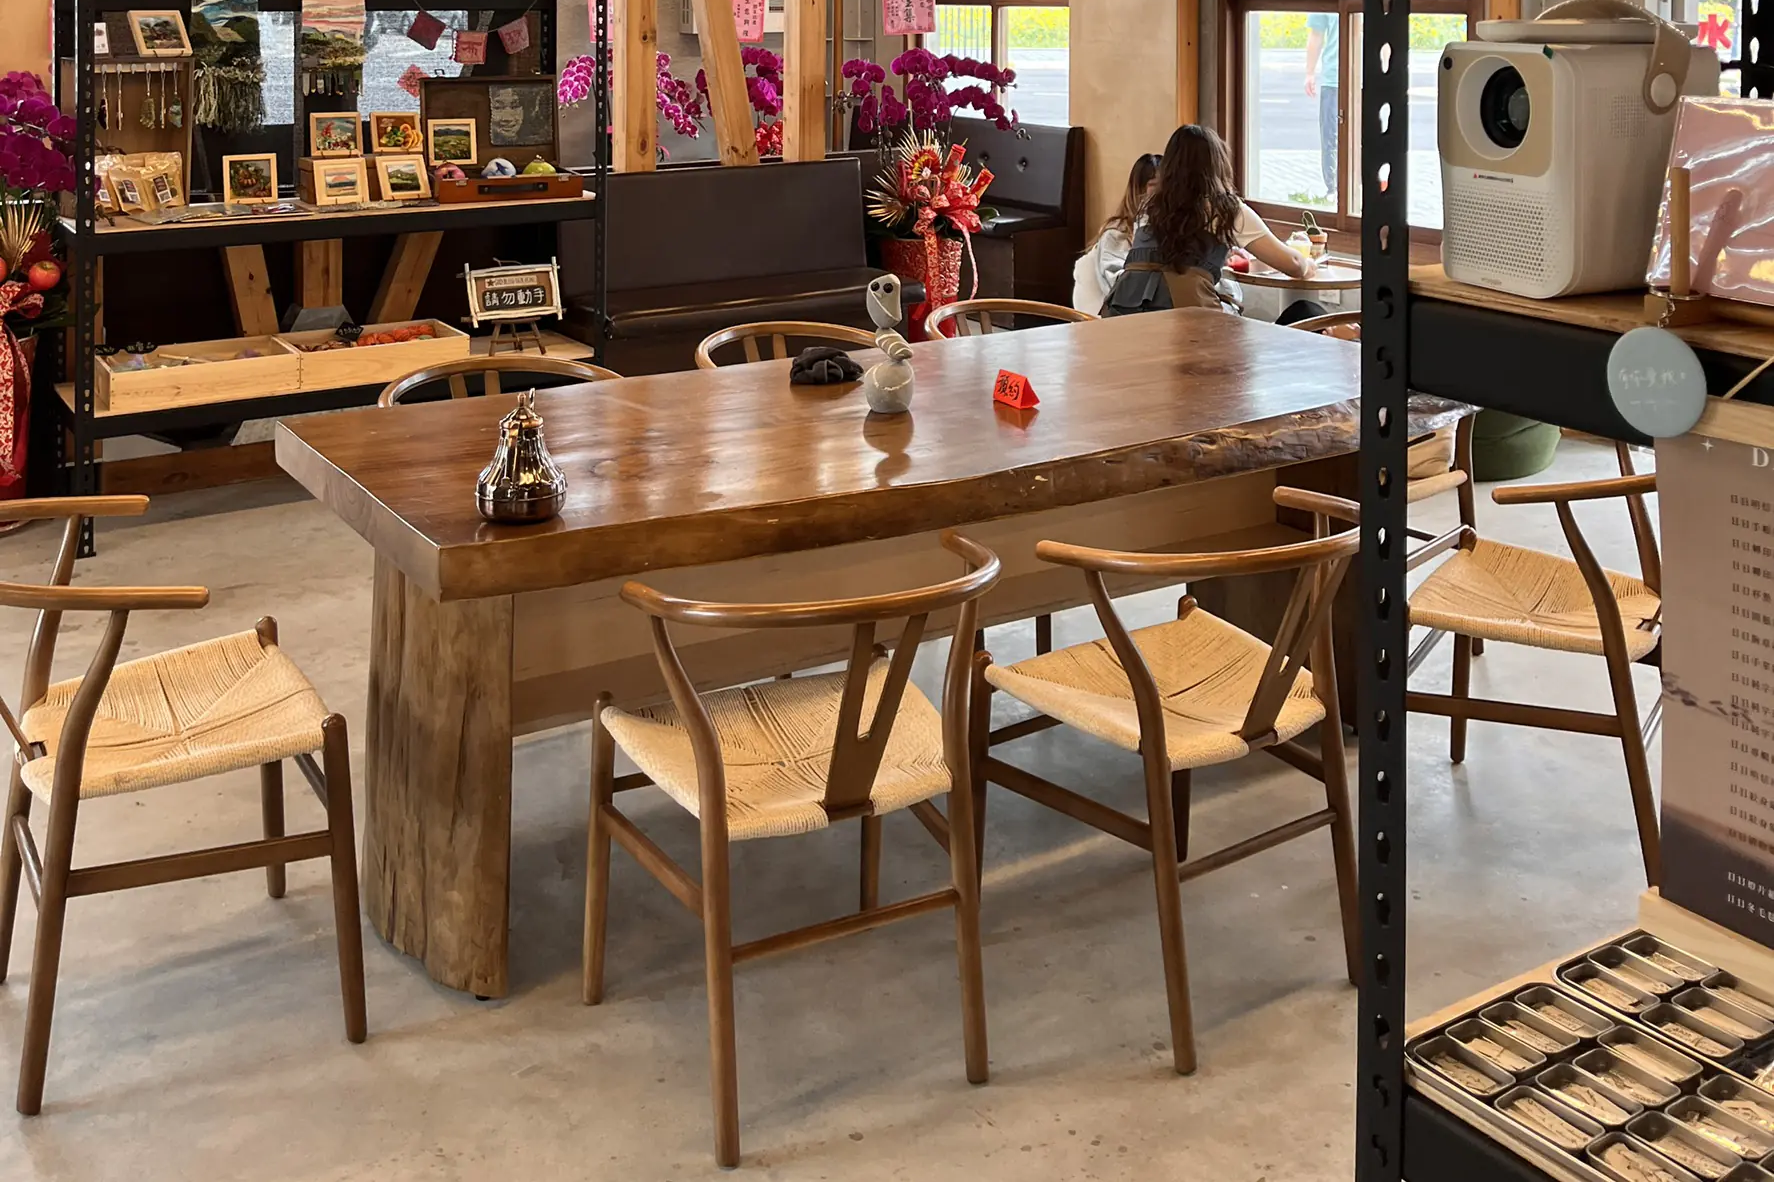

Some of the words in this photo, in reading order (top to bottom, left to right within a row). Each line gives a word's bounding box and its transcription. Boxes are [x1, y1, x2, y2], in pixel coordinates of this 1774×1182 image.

[484, 288, 545, 307] 請勿動手
[1752, 446, 1774, 470] D
